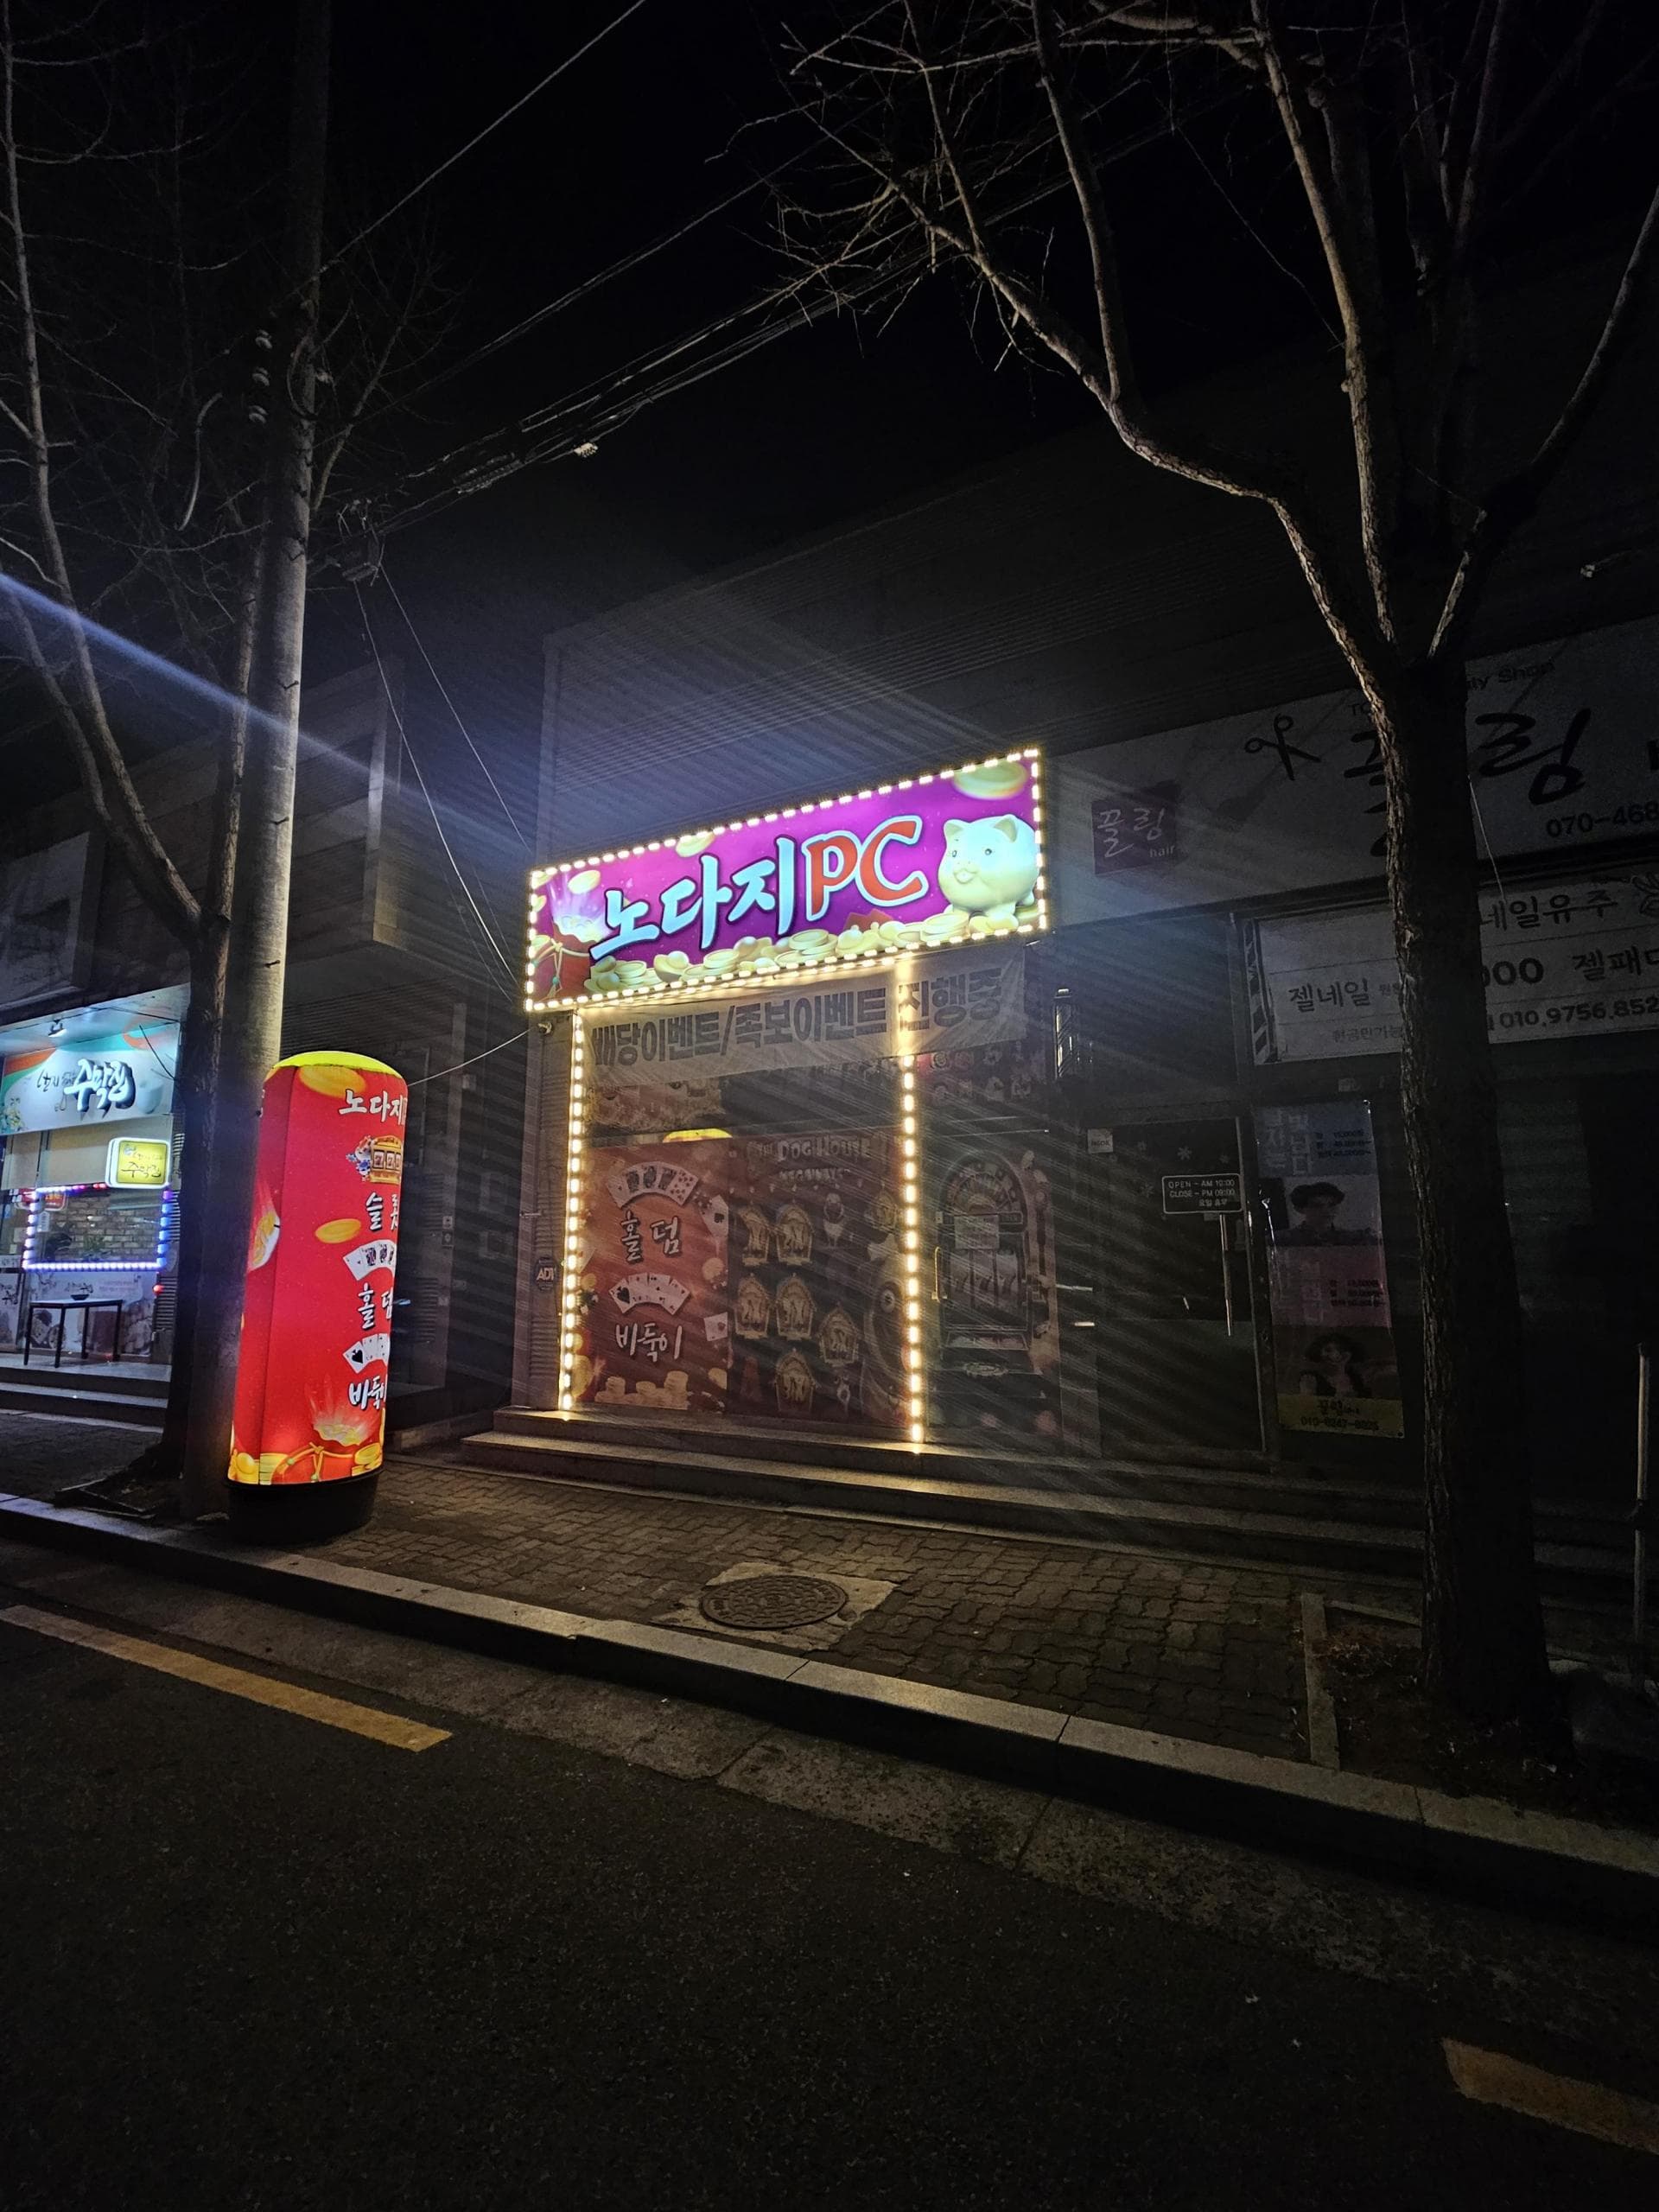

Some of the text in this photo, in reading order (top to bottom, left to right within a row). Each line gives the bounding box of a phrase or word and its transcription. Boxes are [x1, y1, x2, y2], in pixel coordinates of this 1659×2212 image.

[1149, 845, 1175, 858] hair
[589, 814, 929, 959] 노다지PC
[899, 967, 1002, 1032] 진행중
[1288, 977, 1372, 1014] 젤네일
[778, 1139, 812, 1163] DOG
[1168, 1180, 1192, 1189] OPEN
[536, 1267, 557, 1281] ADT
